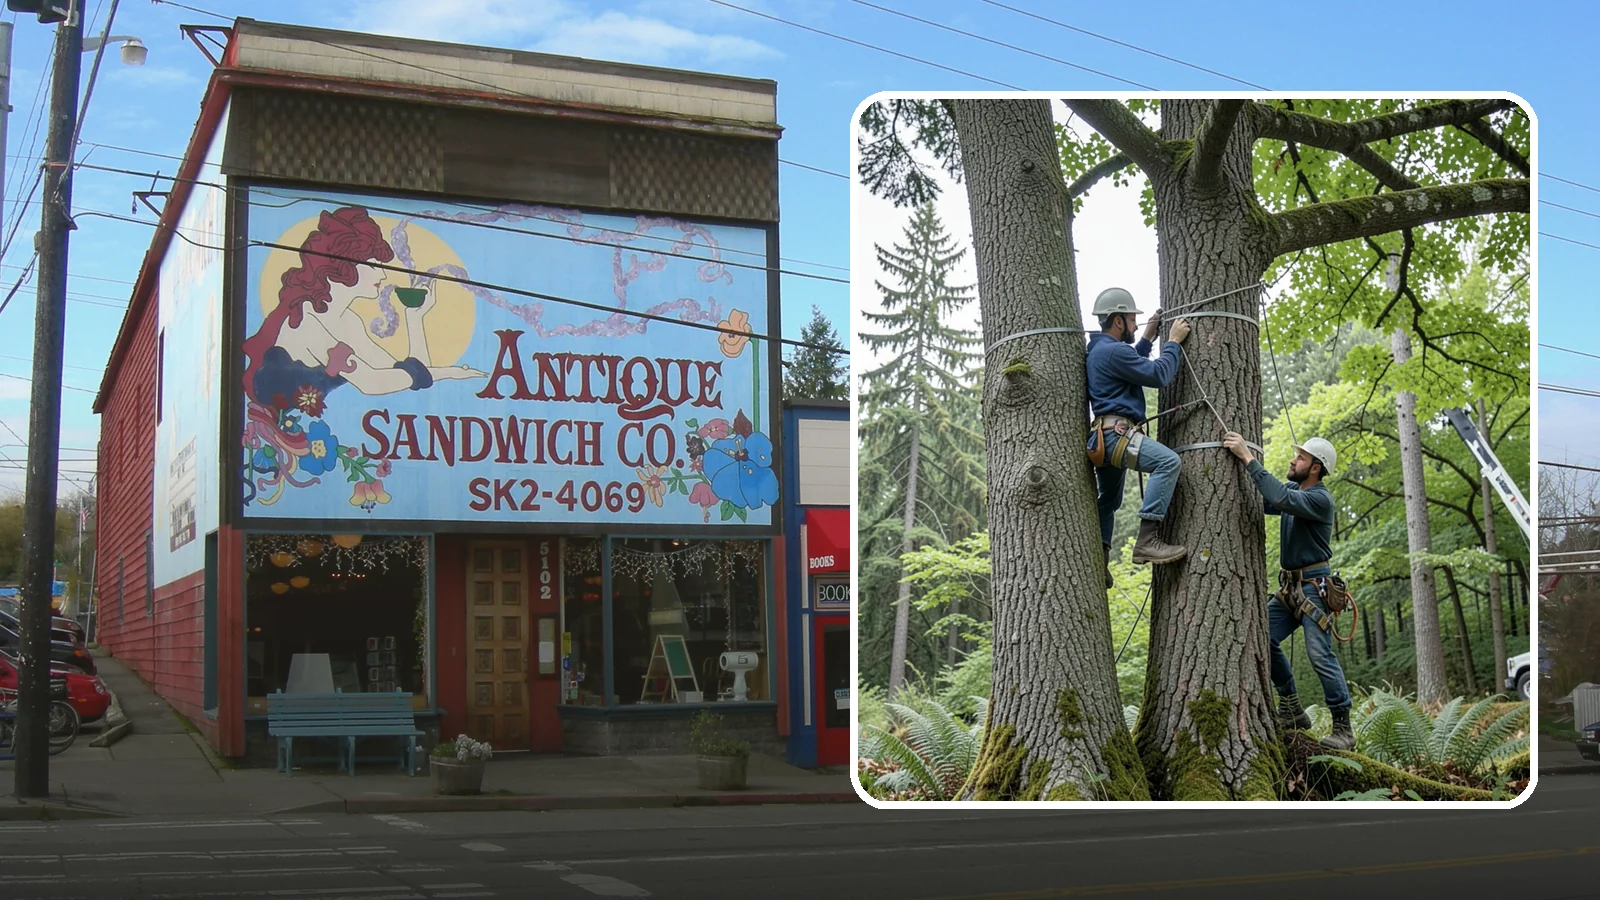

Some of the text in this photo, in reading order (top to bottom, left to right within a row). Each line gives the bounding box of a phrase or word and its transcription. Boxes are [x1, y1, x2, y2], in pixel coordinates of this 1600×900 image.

[475, 329, 723, 420] ANTIQUE
[361, 408, 684, 468] SANDWICH CO.
[468, 478, 645, 513] SK2-4069
[540, 541, 551, 600] 5102
[809, 555, 835, 569] BOOKS
